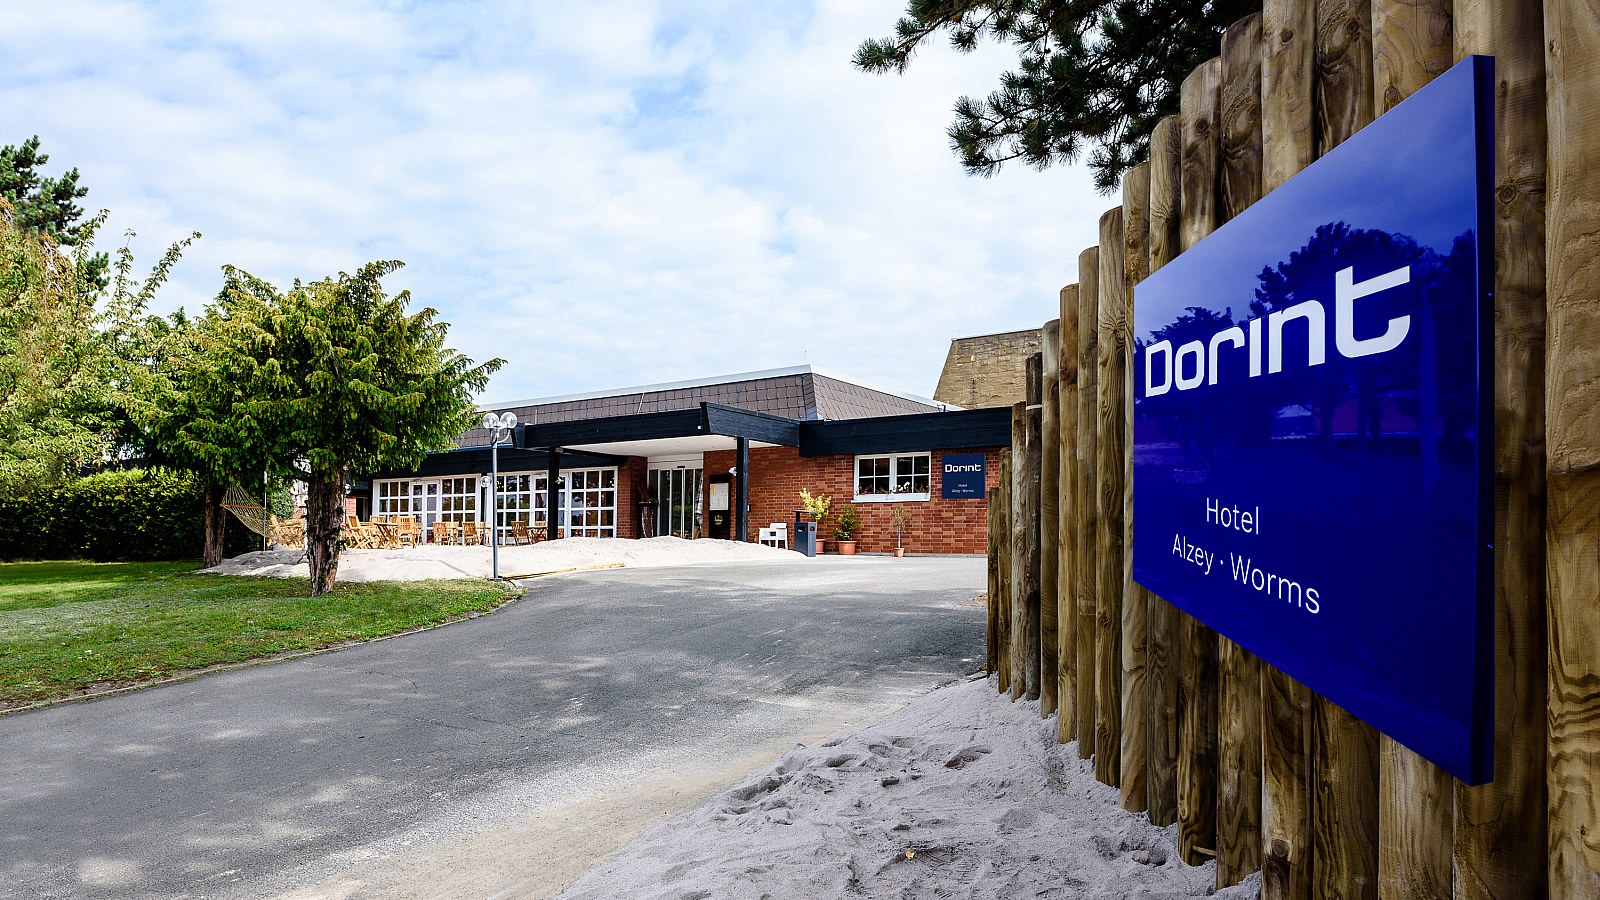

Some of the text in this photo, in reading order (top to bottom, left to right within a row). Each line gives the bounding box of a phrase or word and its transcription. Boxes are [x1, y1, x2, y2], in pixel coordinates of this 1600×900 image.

[1145, 265, 1411, 398] Dorint
[944, 463, 982, 473] Dorint
[1206, 497, 1260, 535] Hotel
[1172, 533, 1214, 576] Alzey
[1230, 552, 1320, 614] Worms
